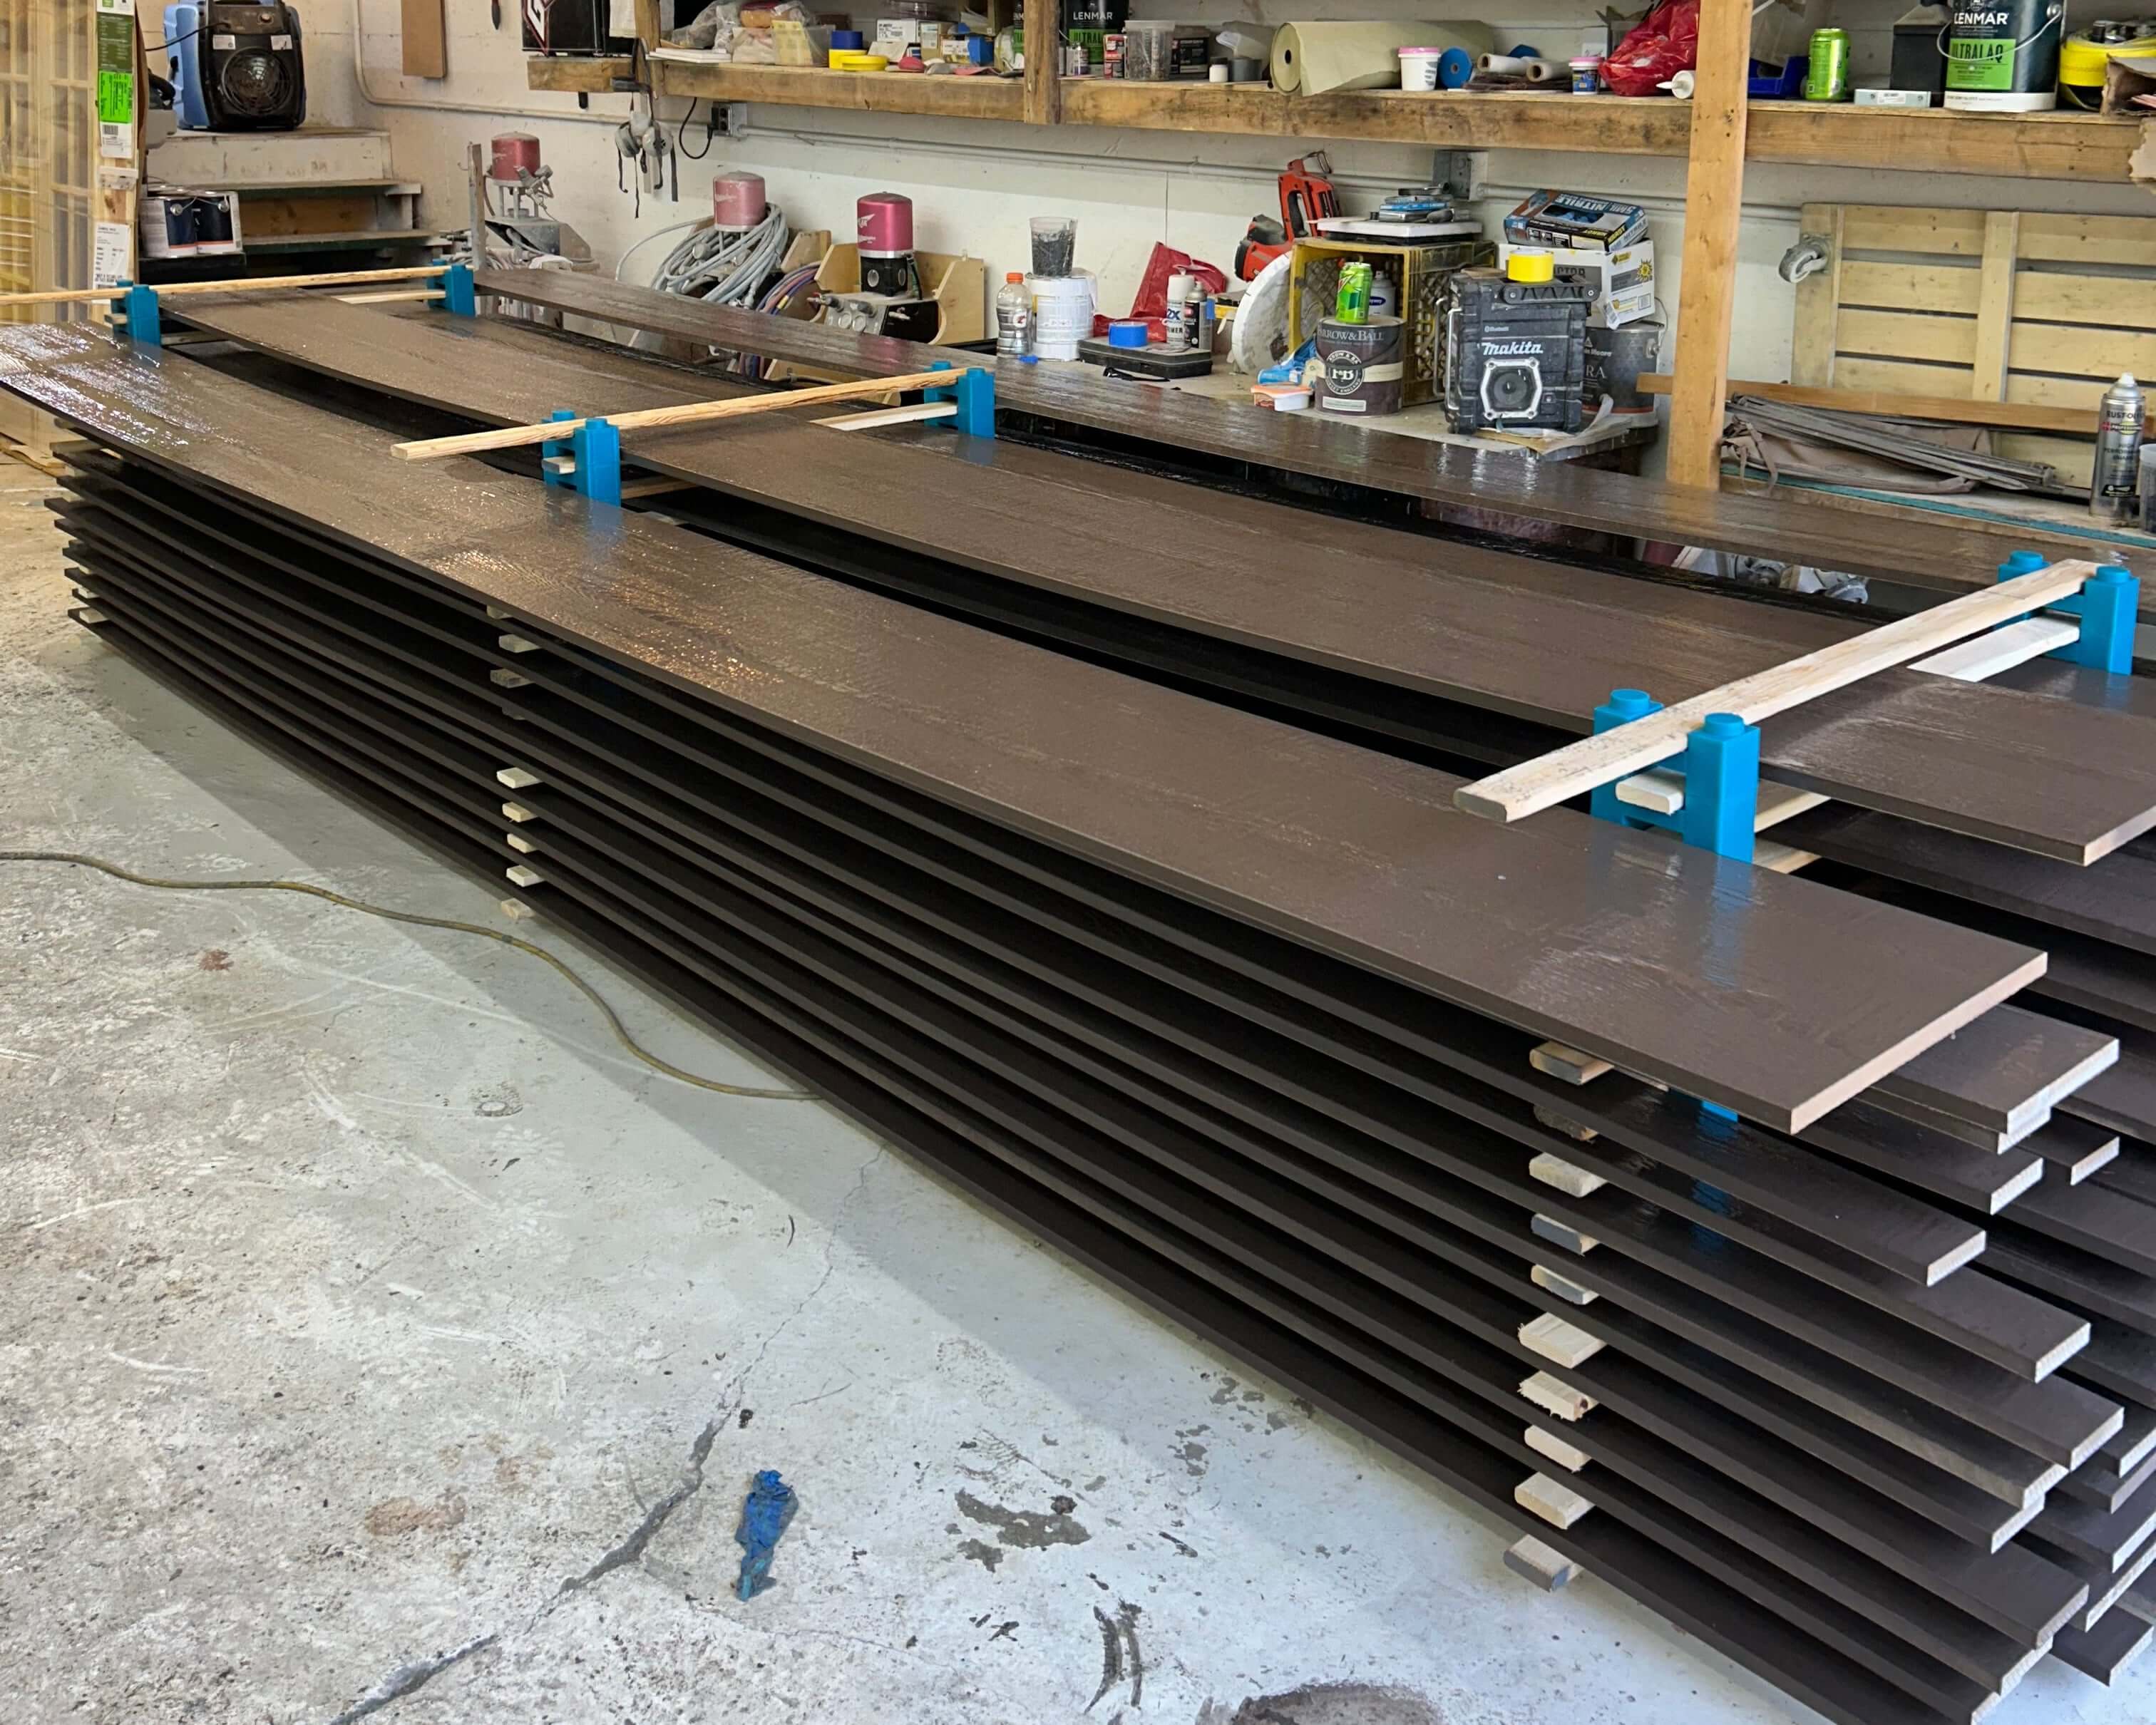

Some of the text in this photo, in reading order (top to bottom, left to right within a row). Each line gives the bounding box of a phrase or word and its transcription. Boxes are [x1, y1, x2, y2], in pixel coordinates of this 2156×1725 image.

[1072, 11, 1113, 21] LENMAR
[1954, 12, 2008, 25] LENMAR
[1585, 364, 1608, 379] RA
